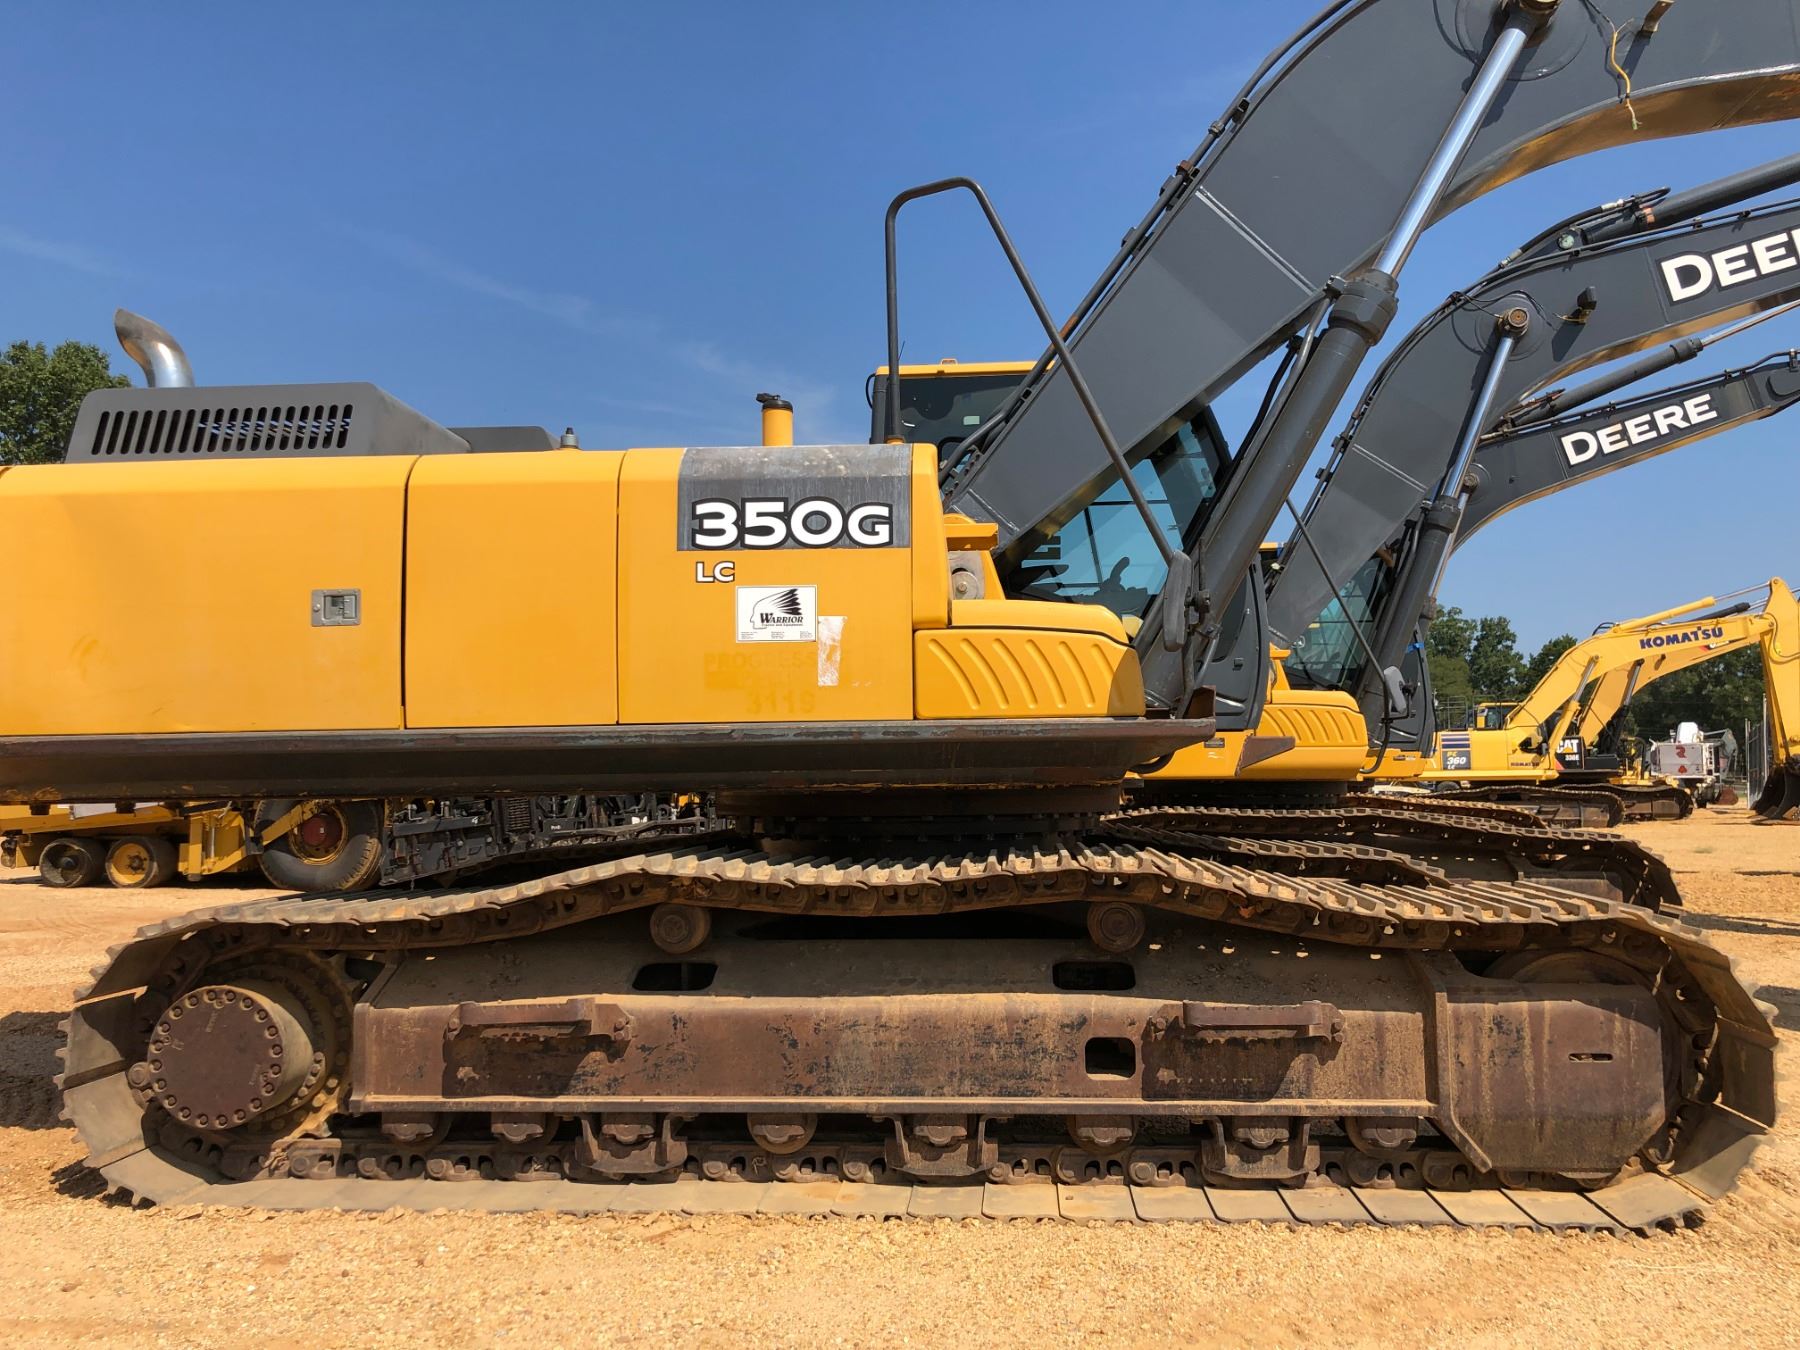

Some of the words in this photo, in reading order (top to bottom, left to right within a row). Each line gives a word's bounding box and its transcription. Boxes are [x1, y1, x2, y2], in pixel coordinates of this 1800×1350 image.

[1659, 227, 1800, 302] DEE
[1560, 393, 1718, 466] DEERE
[692, 497, 893, 549] 350G
[696, 561, 735, 583] LC
[1639, 626, 1724, 649] KOMATSU
[704, 652, 816, 669] PROGESS
[1556, 739, 1579, 753] CAT
[1446, 756, 1467, 765] 360
